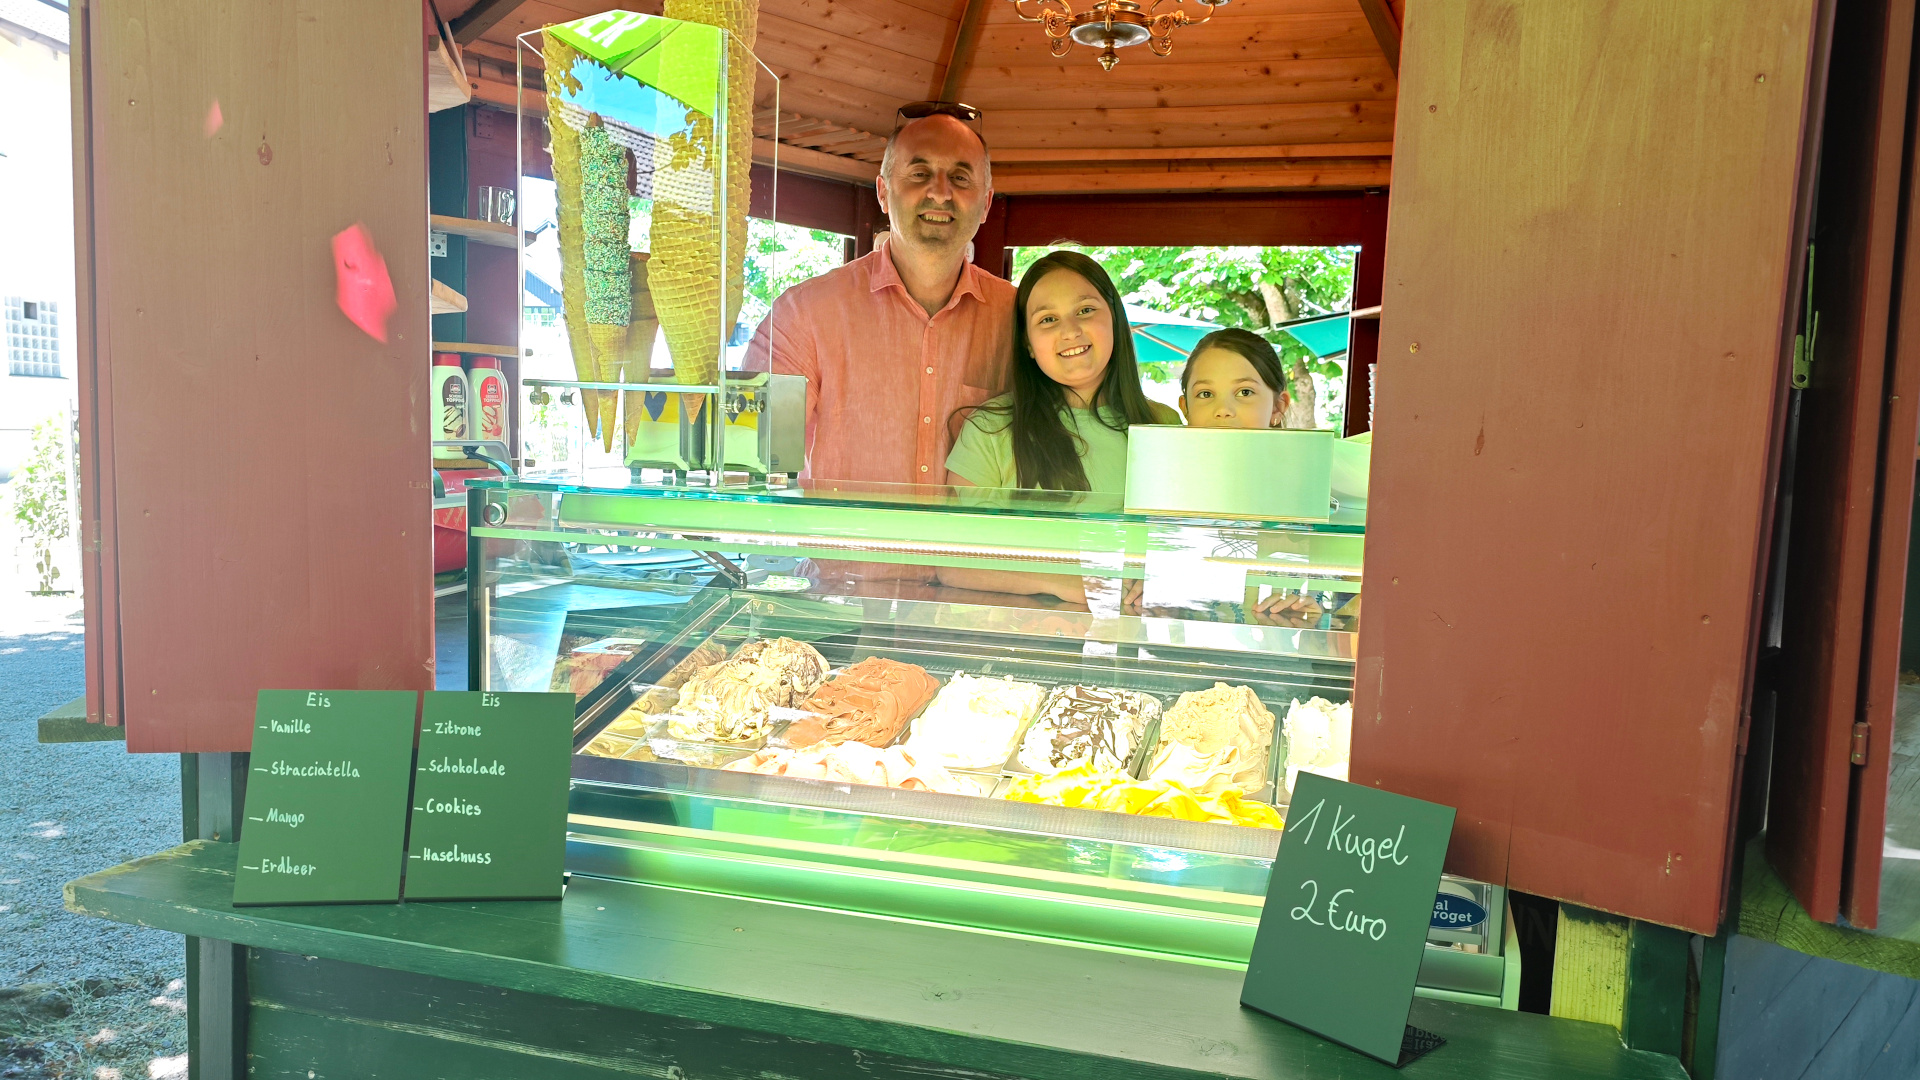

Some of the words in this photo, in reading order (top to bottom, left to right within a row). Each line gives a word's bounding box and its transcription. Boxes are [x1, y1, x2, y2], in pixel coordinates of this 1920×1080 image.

[306, 692, 331, 708] Eis
[481, 692, 501, 708] Eis
[1288, 798, 1326, 845] 1
[1326, 804, 1409, 874] Kugel
[1290, 879, 1325, 926] 2
[1435, 900, 1449, 911] al
[1432, 910, 1472, 923] roget
